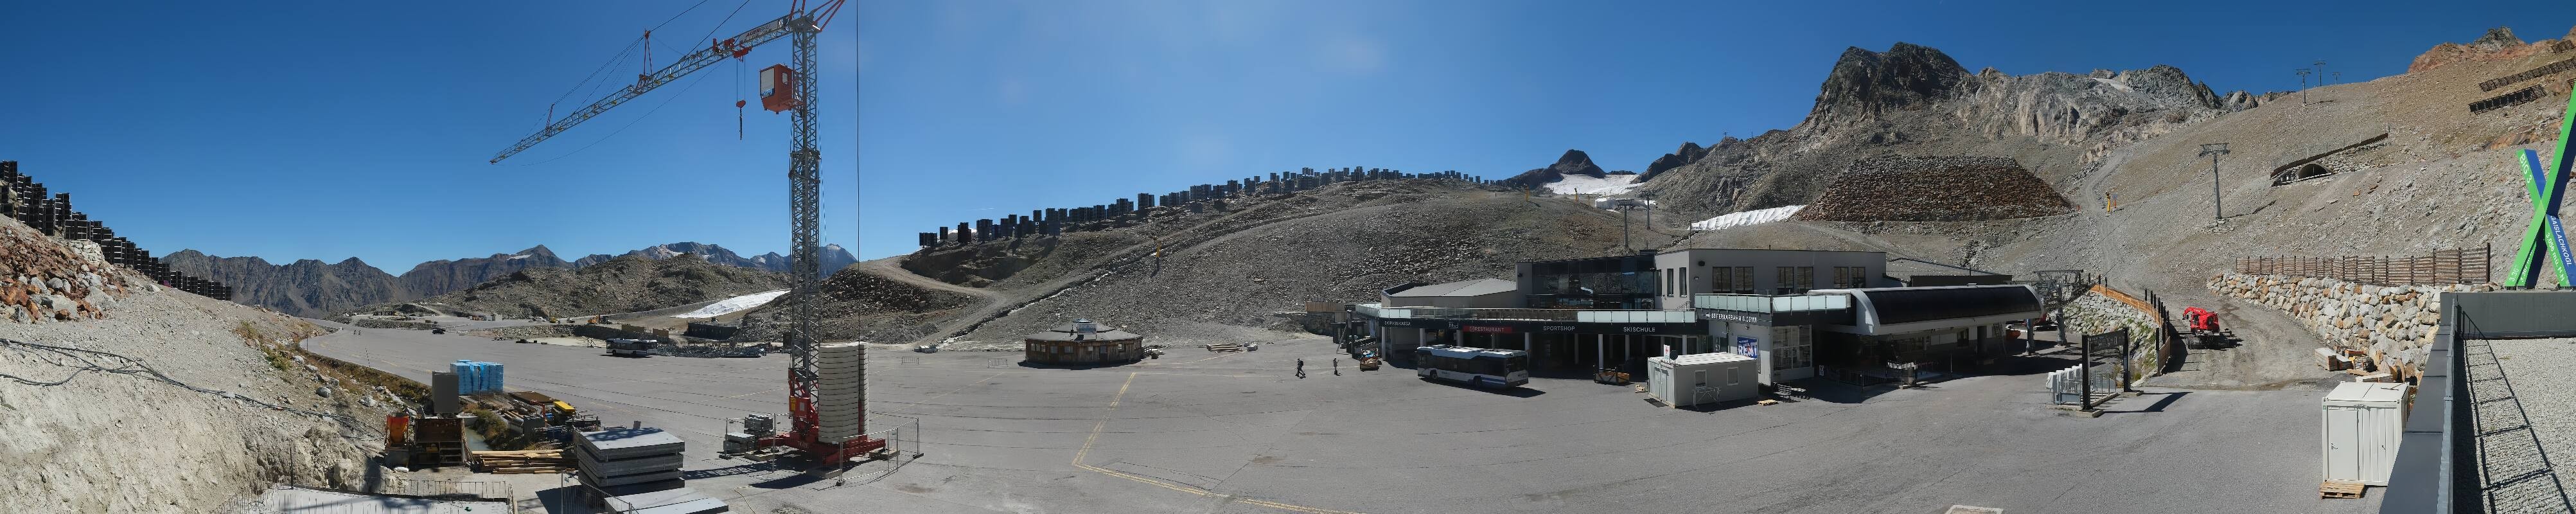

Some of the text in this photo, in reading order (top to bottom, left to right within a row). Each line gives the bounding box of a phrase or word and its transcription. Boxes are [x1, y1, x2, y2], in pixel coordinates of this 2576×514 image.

[2519, 153, 2532, 184] BIG 3
[2550, 215, 2572, 267] GAISLACHKOGL
